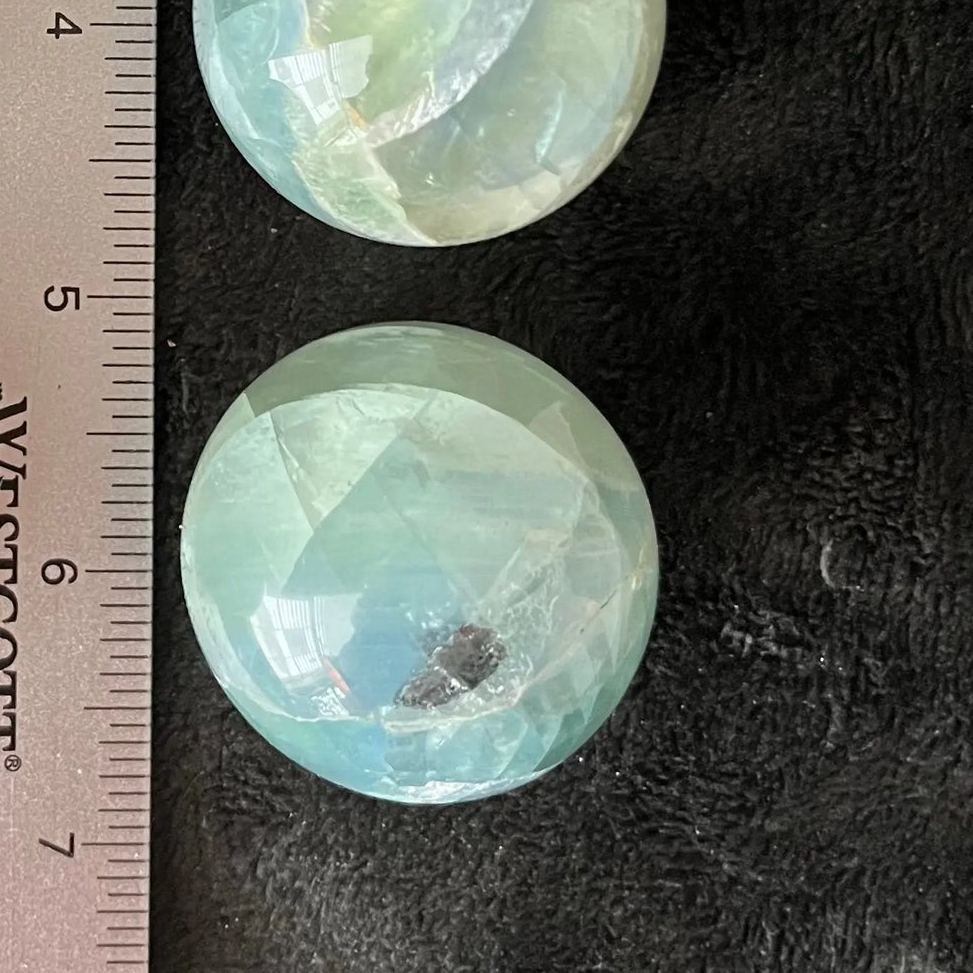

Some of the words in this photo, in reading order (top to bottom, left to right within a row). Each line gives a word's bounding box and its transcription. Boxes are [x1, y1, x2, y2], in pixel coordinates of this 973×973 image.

[47, 12, 82, 39] 4
[44, 286, 80, 312] 5
[41, 559, 78, 585] 6
[39, 833, 75, 858] 7
